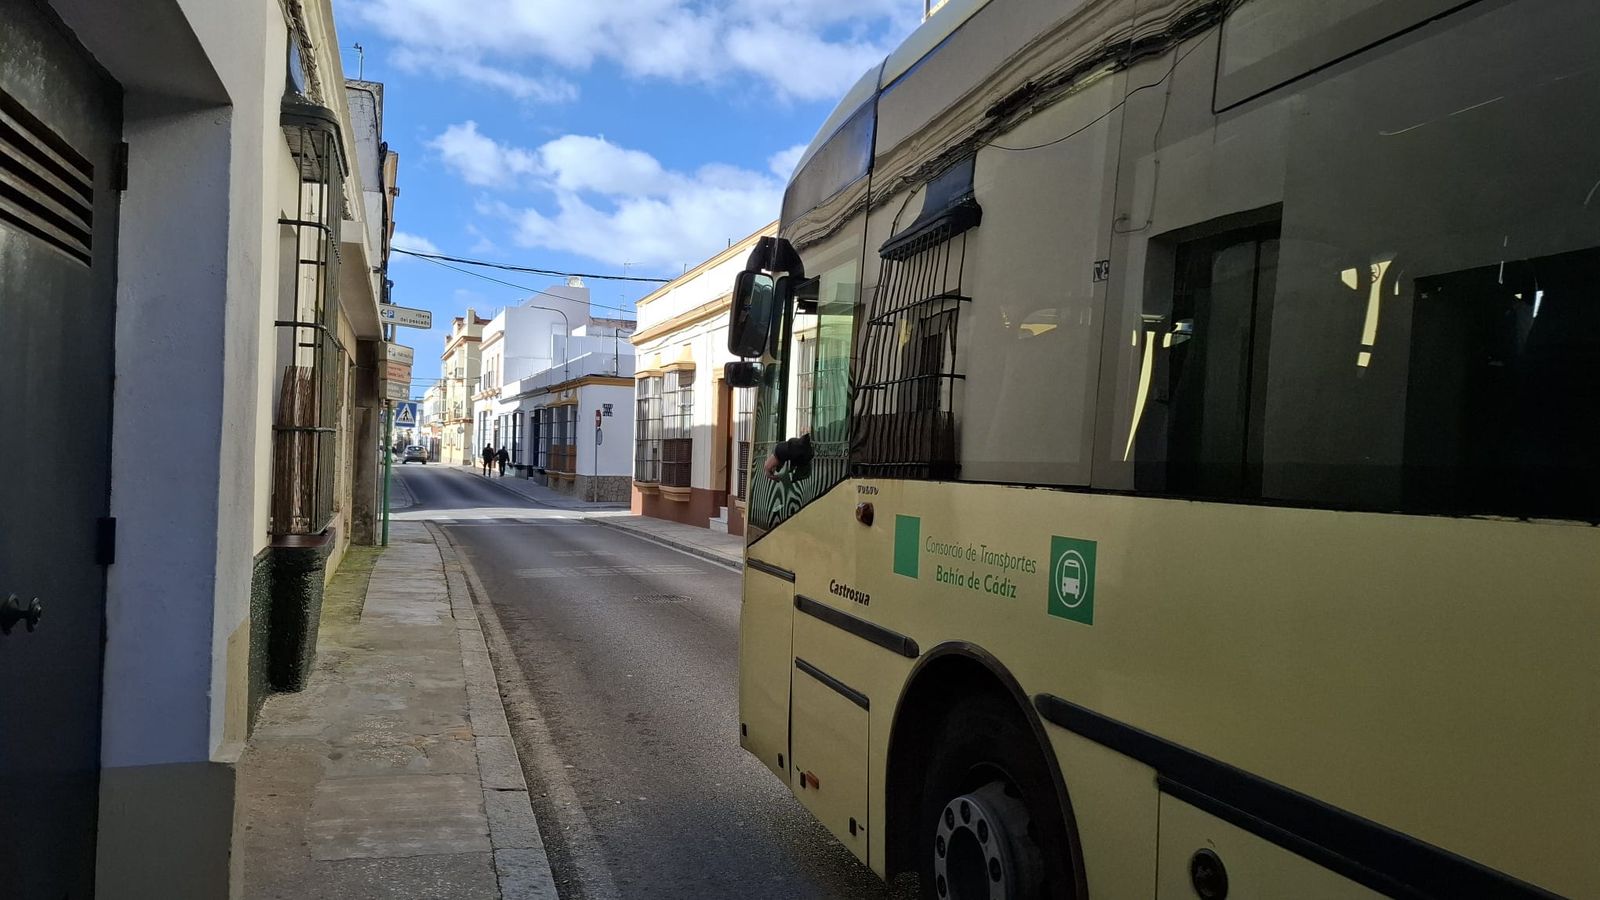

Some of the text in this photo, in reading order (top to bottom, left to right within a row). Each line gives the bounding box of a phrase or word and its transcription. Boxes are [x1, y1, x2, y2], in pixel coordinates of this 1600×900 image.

[925, 535, 1037, 574] Consorcio de Transportes
[829, 579, 870, 606] Castrosua
[936, 565, 1017, 599] Bahía de Cádiz
